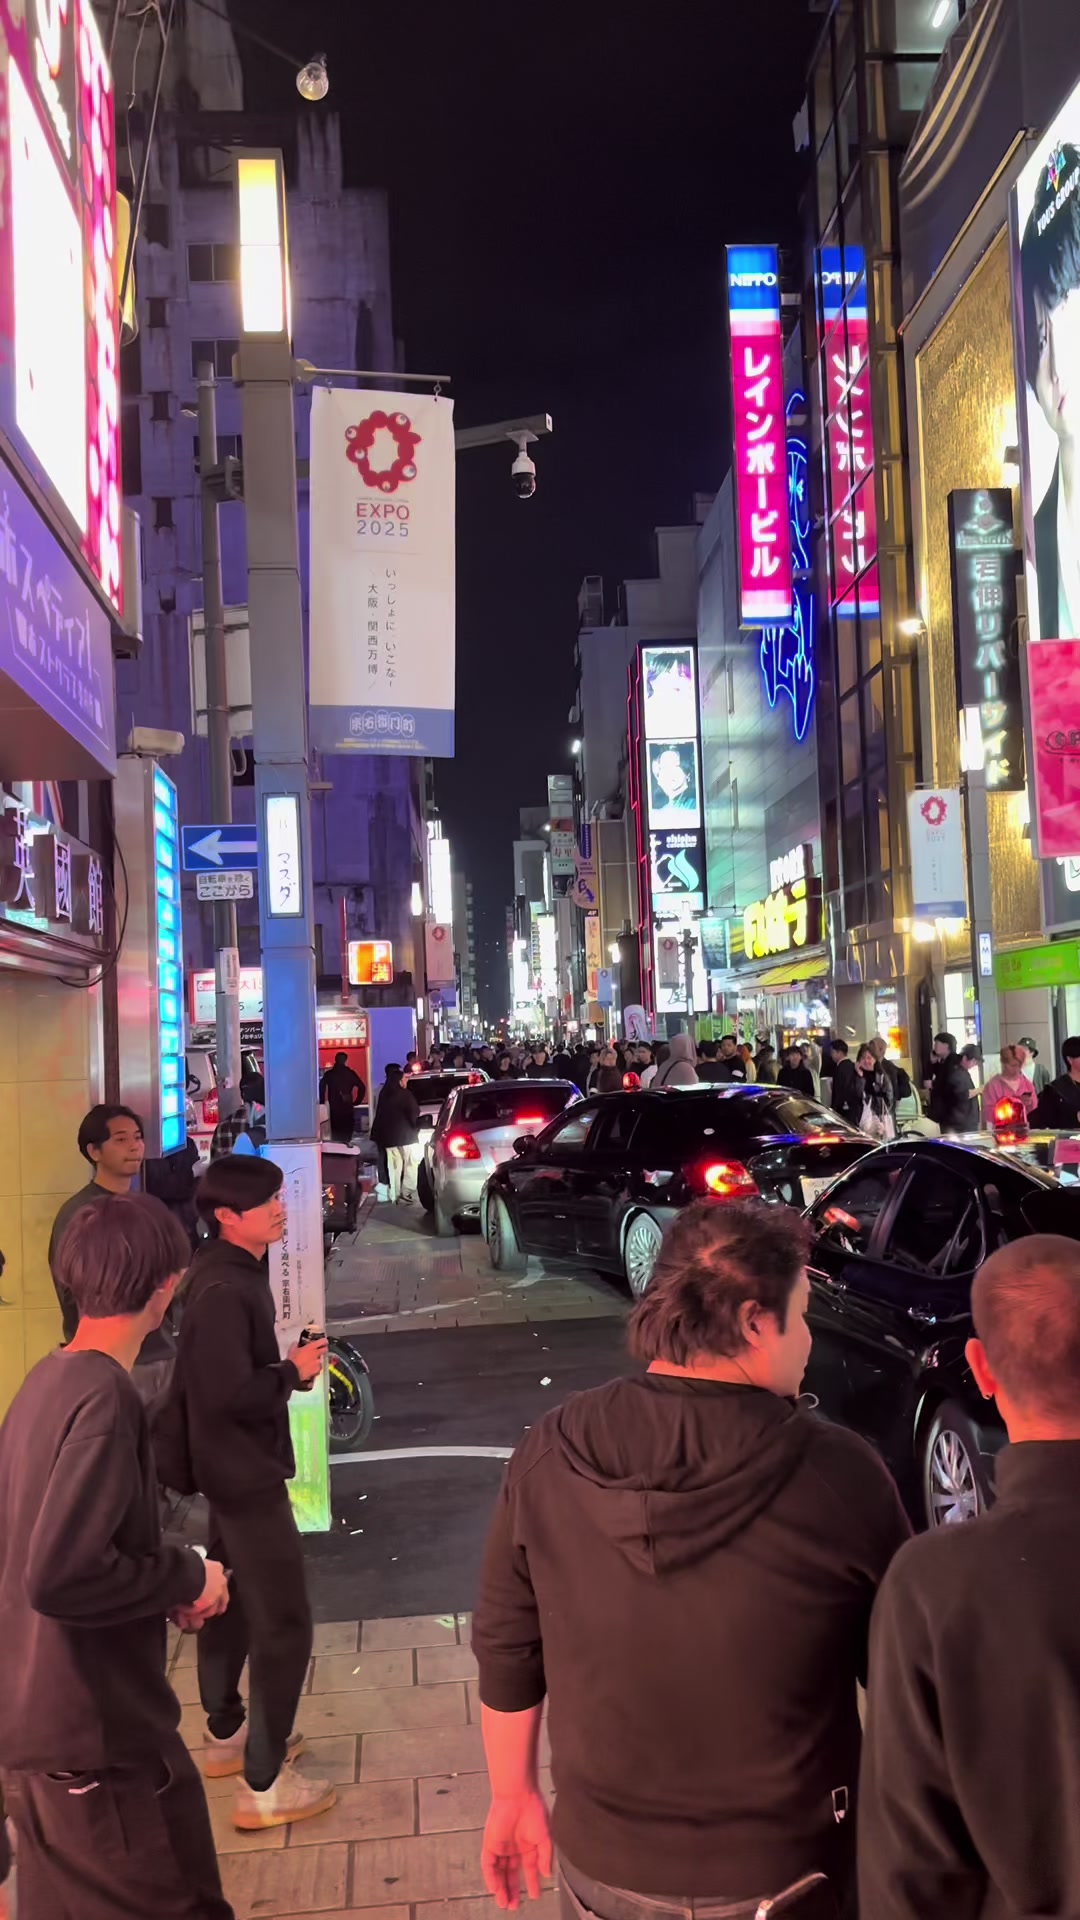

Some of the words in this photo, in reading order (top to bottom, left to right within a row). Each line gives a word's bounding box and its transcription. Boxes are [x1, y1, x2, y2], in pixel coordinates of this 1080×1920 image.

[730, 272, 777, 286] NIPPO
[743, 346, 781, 578] レインボービル
[356, 502, 410, 520] EXPO
[357, 519, 409, 537] 2025
[367, 583, 378, 675] 大阪・関西万博
[200, 884, 251, 898] ここから
